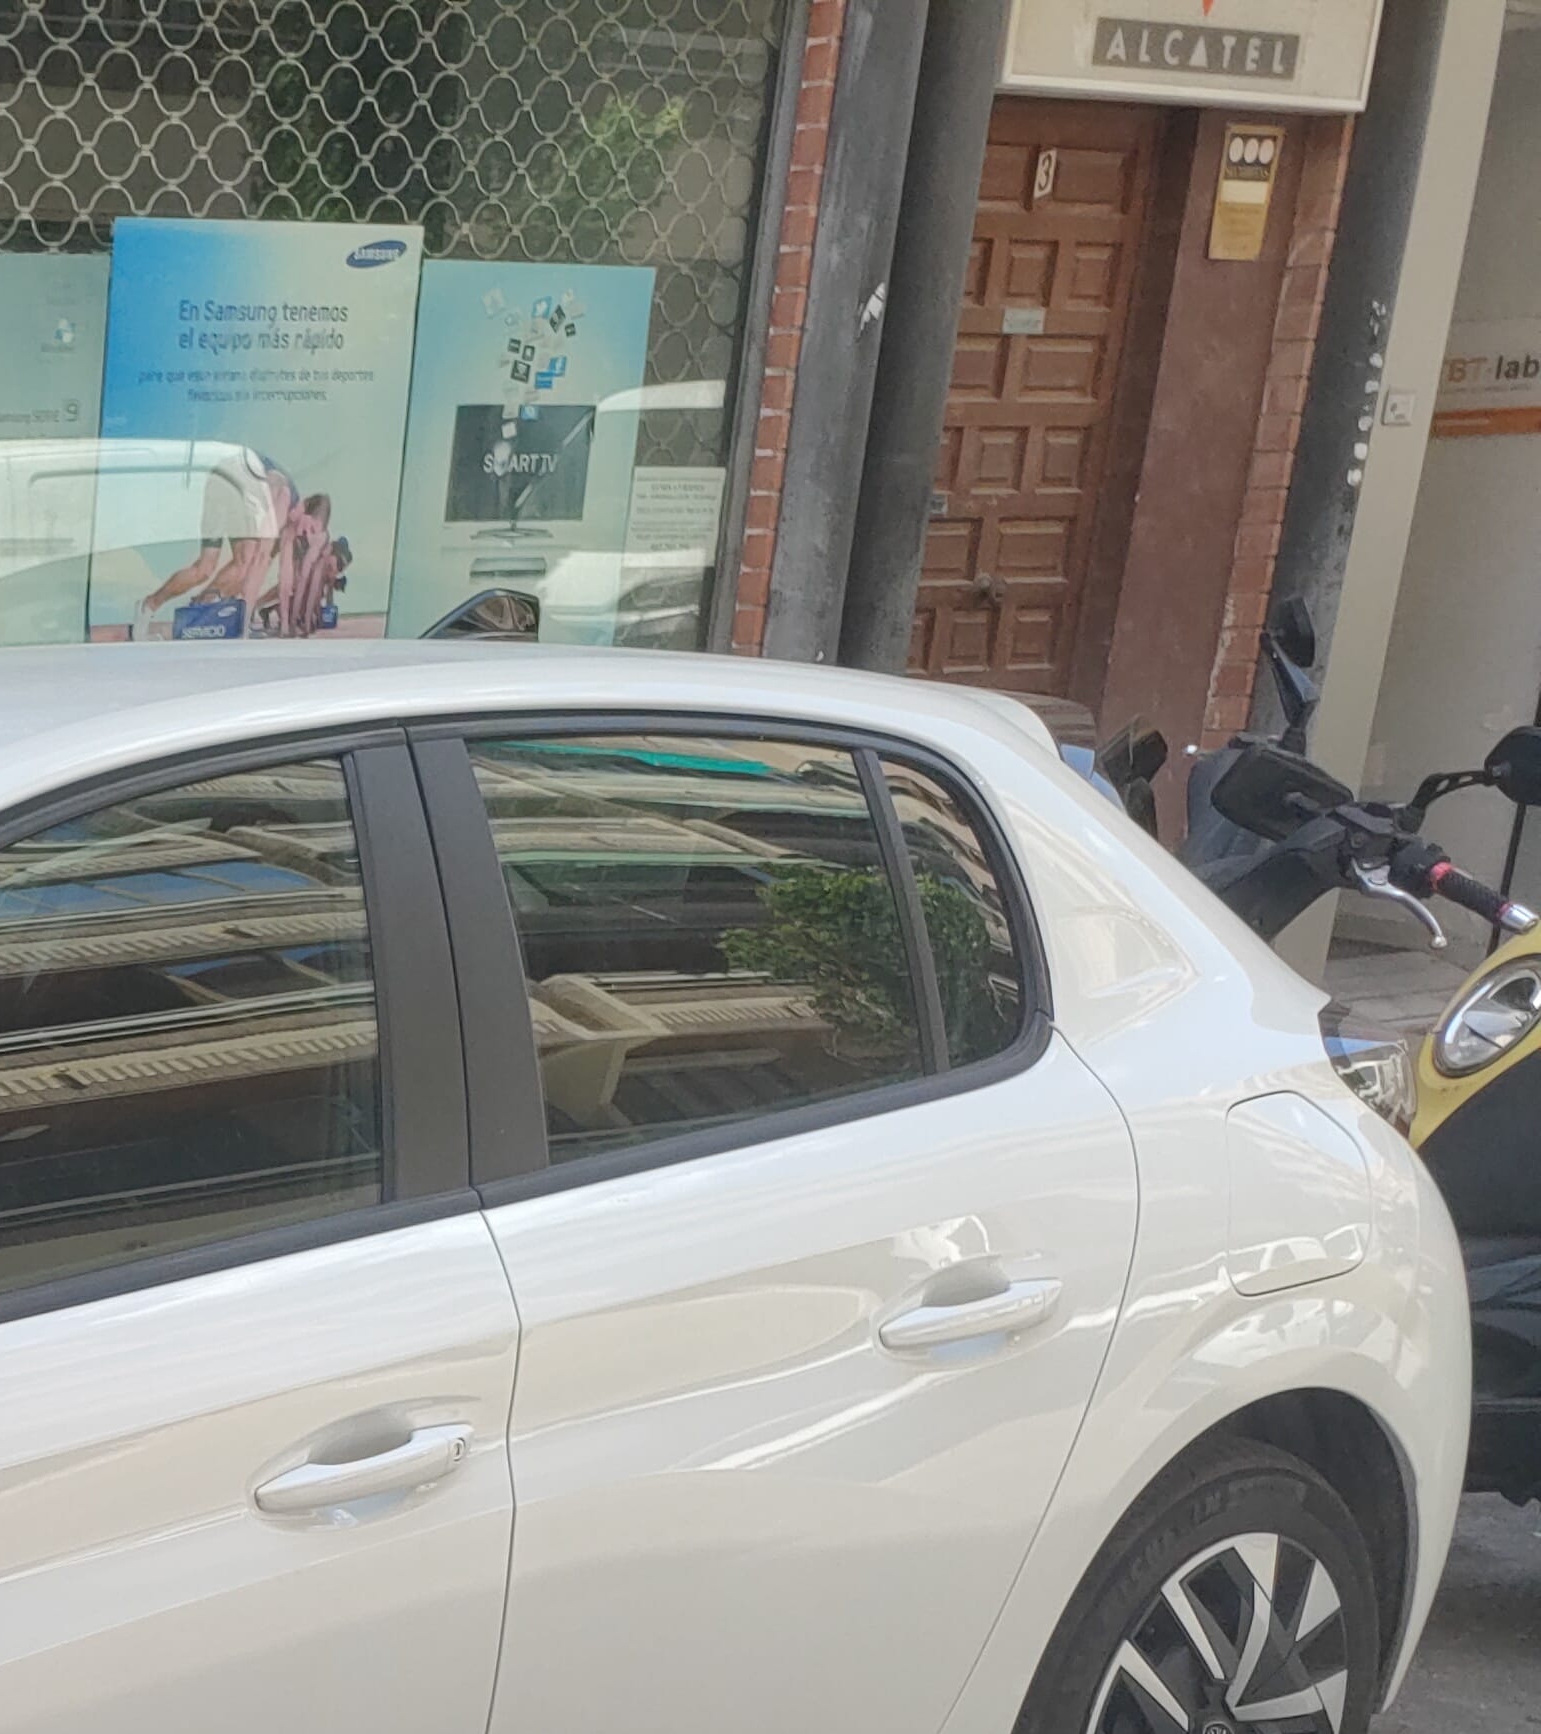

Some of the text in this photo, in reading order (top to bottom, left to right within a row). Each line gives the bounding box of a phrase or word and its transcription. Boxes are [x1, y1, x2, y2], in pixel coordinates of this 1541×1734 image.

[1106, 26, 1284, 74] ALCATEL
[1038, 153, 1053, 192] 3
[353, 247, 400, 262] SAMSUNG
[179, 301, 349, 327] En Samsung tenemos
[179, 328, 345, 356] el equipo más rápido
[483, 453, 539, 474] SART
